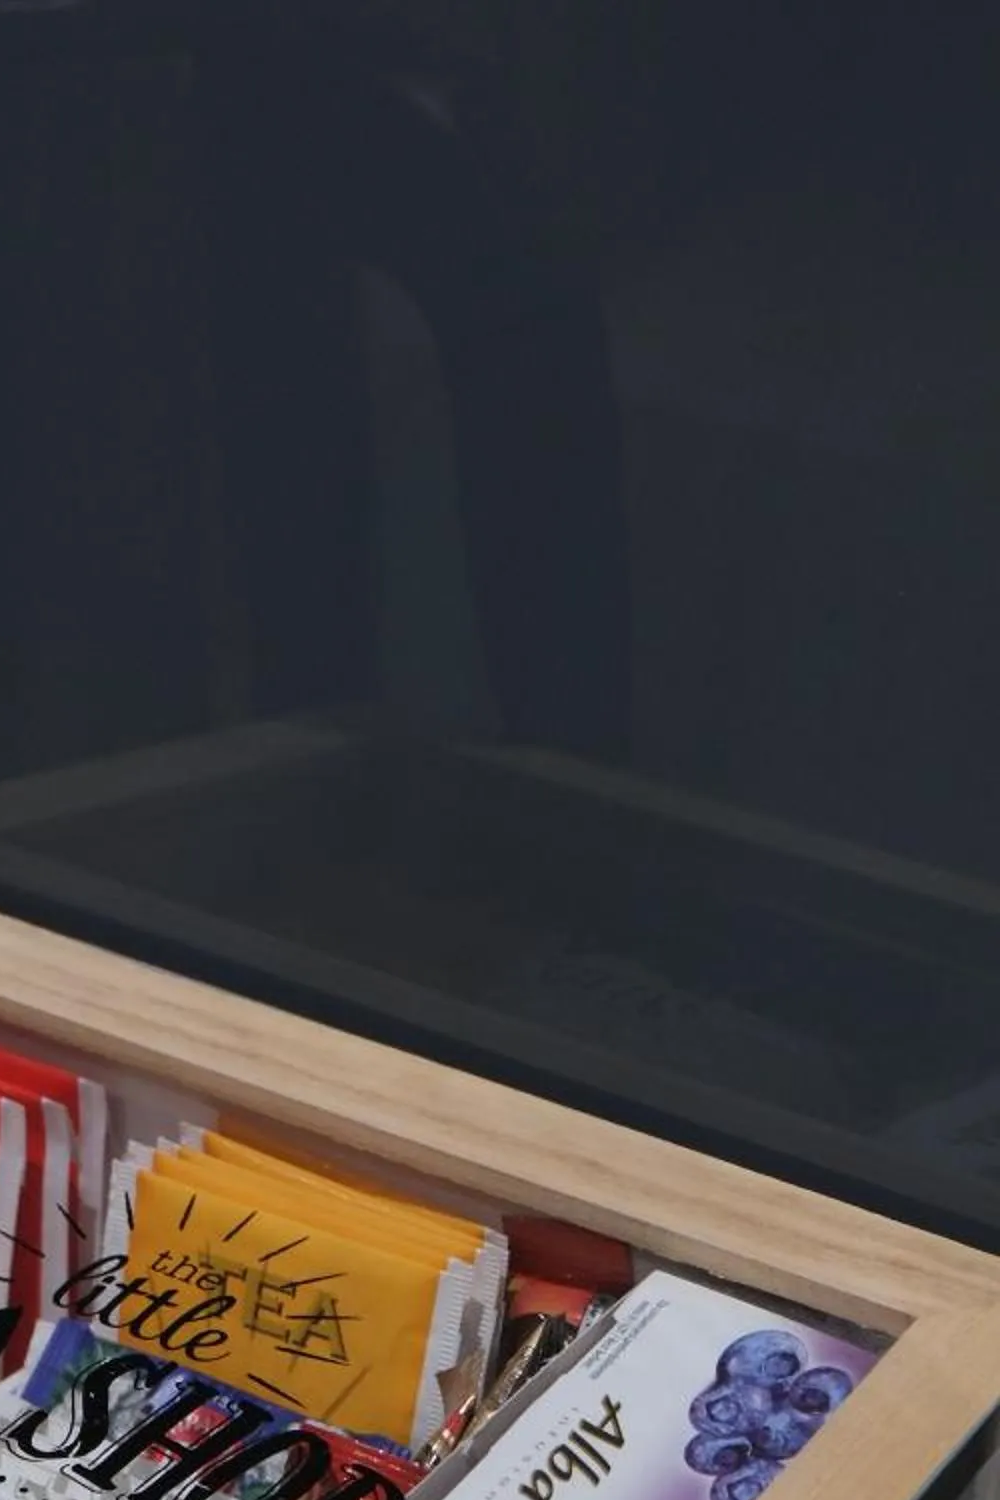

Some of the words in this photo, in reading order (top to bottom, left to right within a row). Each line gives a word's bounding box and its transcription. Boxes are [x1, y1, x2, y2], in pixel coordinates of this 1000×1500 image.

[52, 1255, 231, 1362] little
[151, 1248, 222, 1293] the
[199, 1252, 348, 1362] TEA
